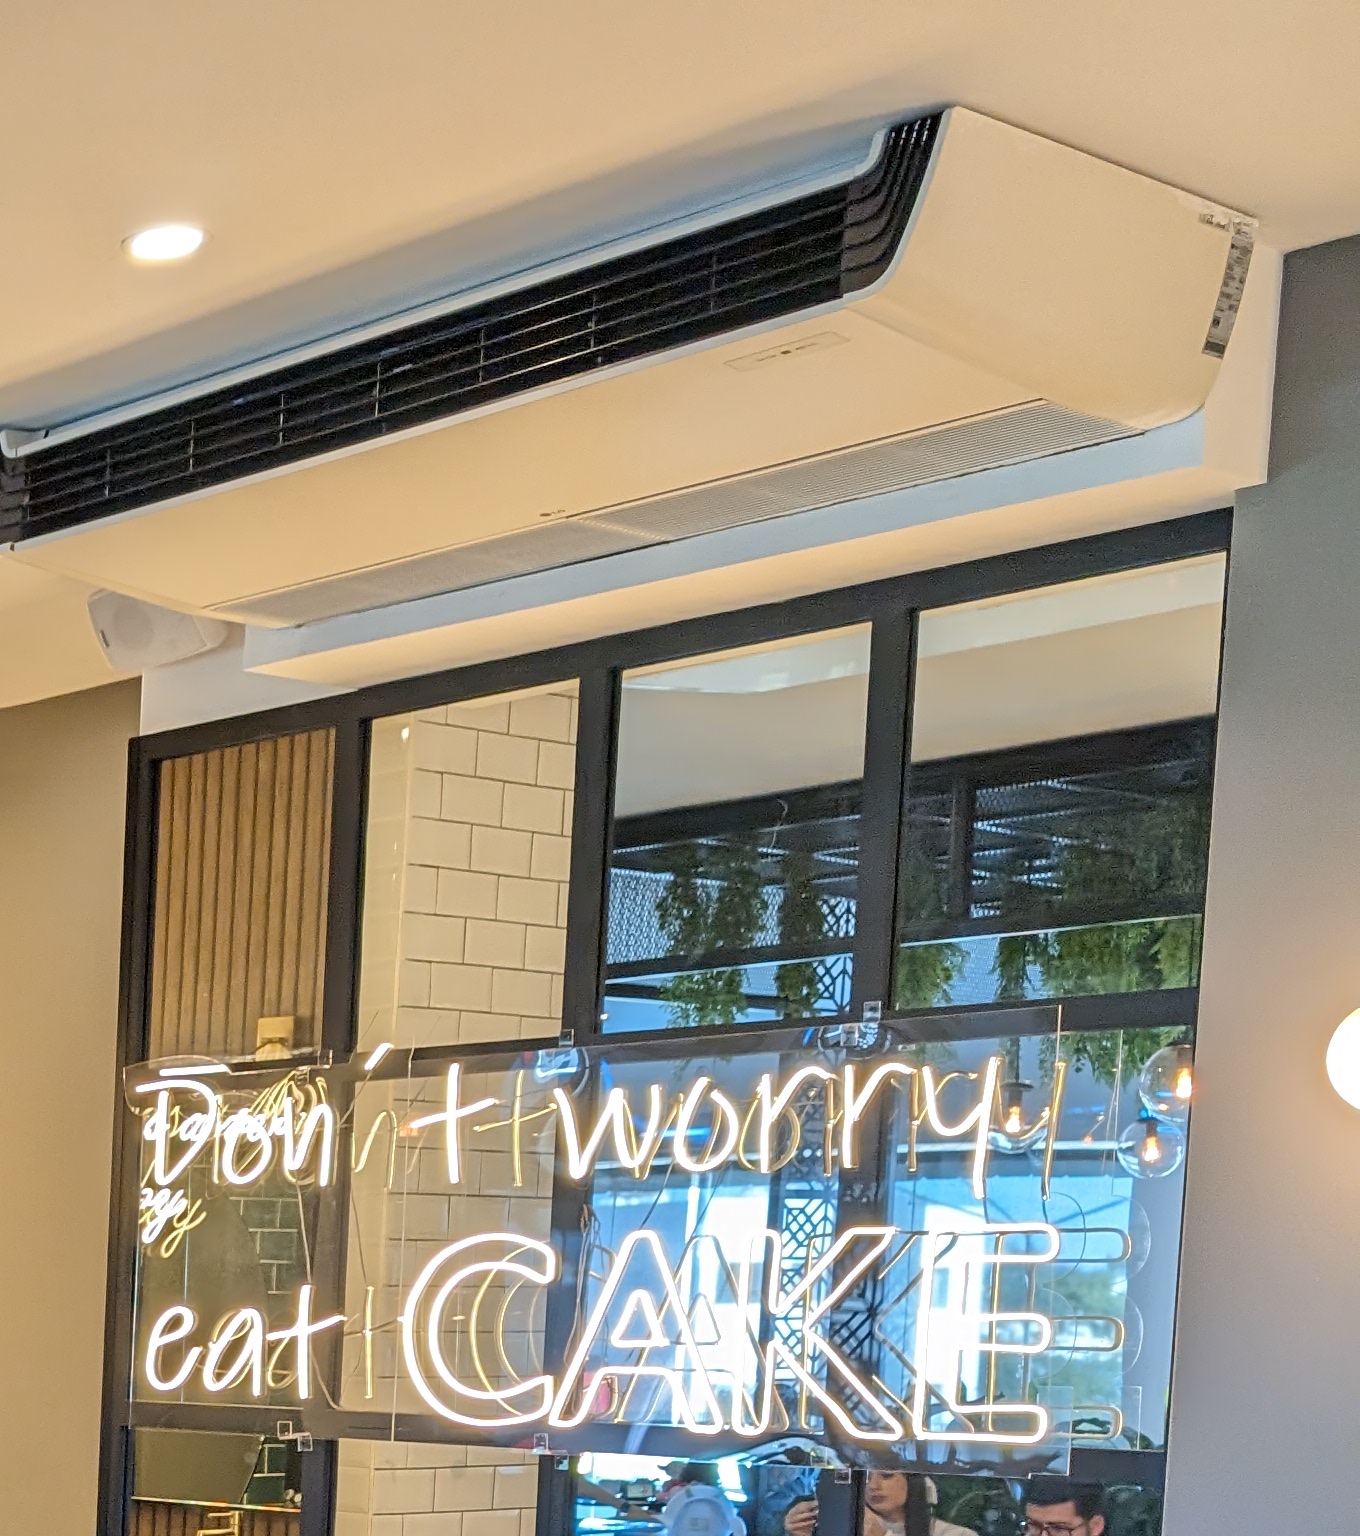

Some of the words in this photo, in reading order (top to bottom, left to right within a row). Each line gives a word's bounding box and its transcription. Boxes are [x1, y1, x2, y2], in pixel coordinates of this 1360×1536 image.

[136, 1043, 499, 1188] Don't
[553, 1056, 1006, 1200] worry
[145, 1283, 348, 1400] eat
[401, 1223, 1061, 1446] CAKE
